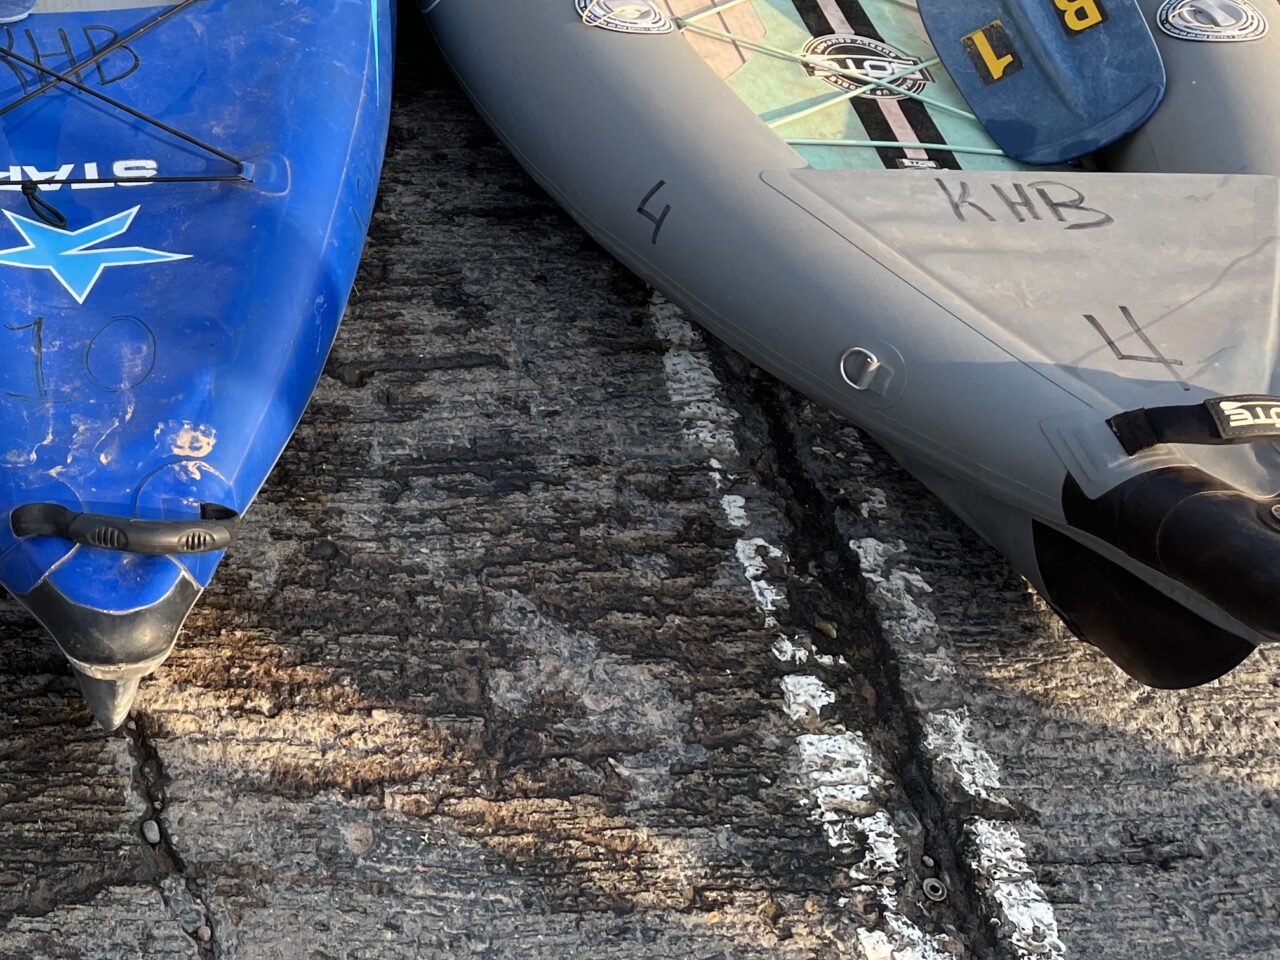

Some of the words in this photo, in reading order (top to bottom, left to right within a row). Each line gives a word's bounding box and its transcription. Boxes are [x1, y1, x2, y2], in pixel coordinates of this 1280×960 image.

[971, 30, 1014, 81] 1
[935, 177, 1115, 231] KHB
[3, 316, 157, 403] 10
[1082, 304, 1191, 392] 4
